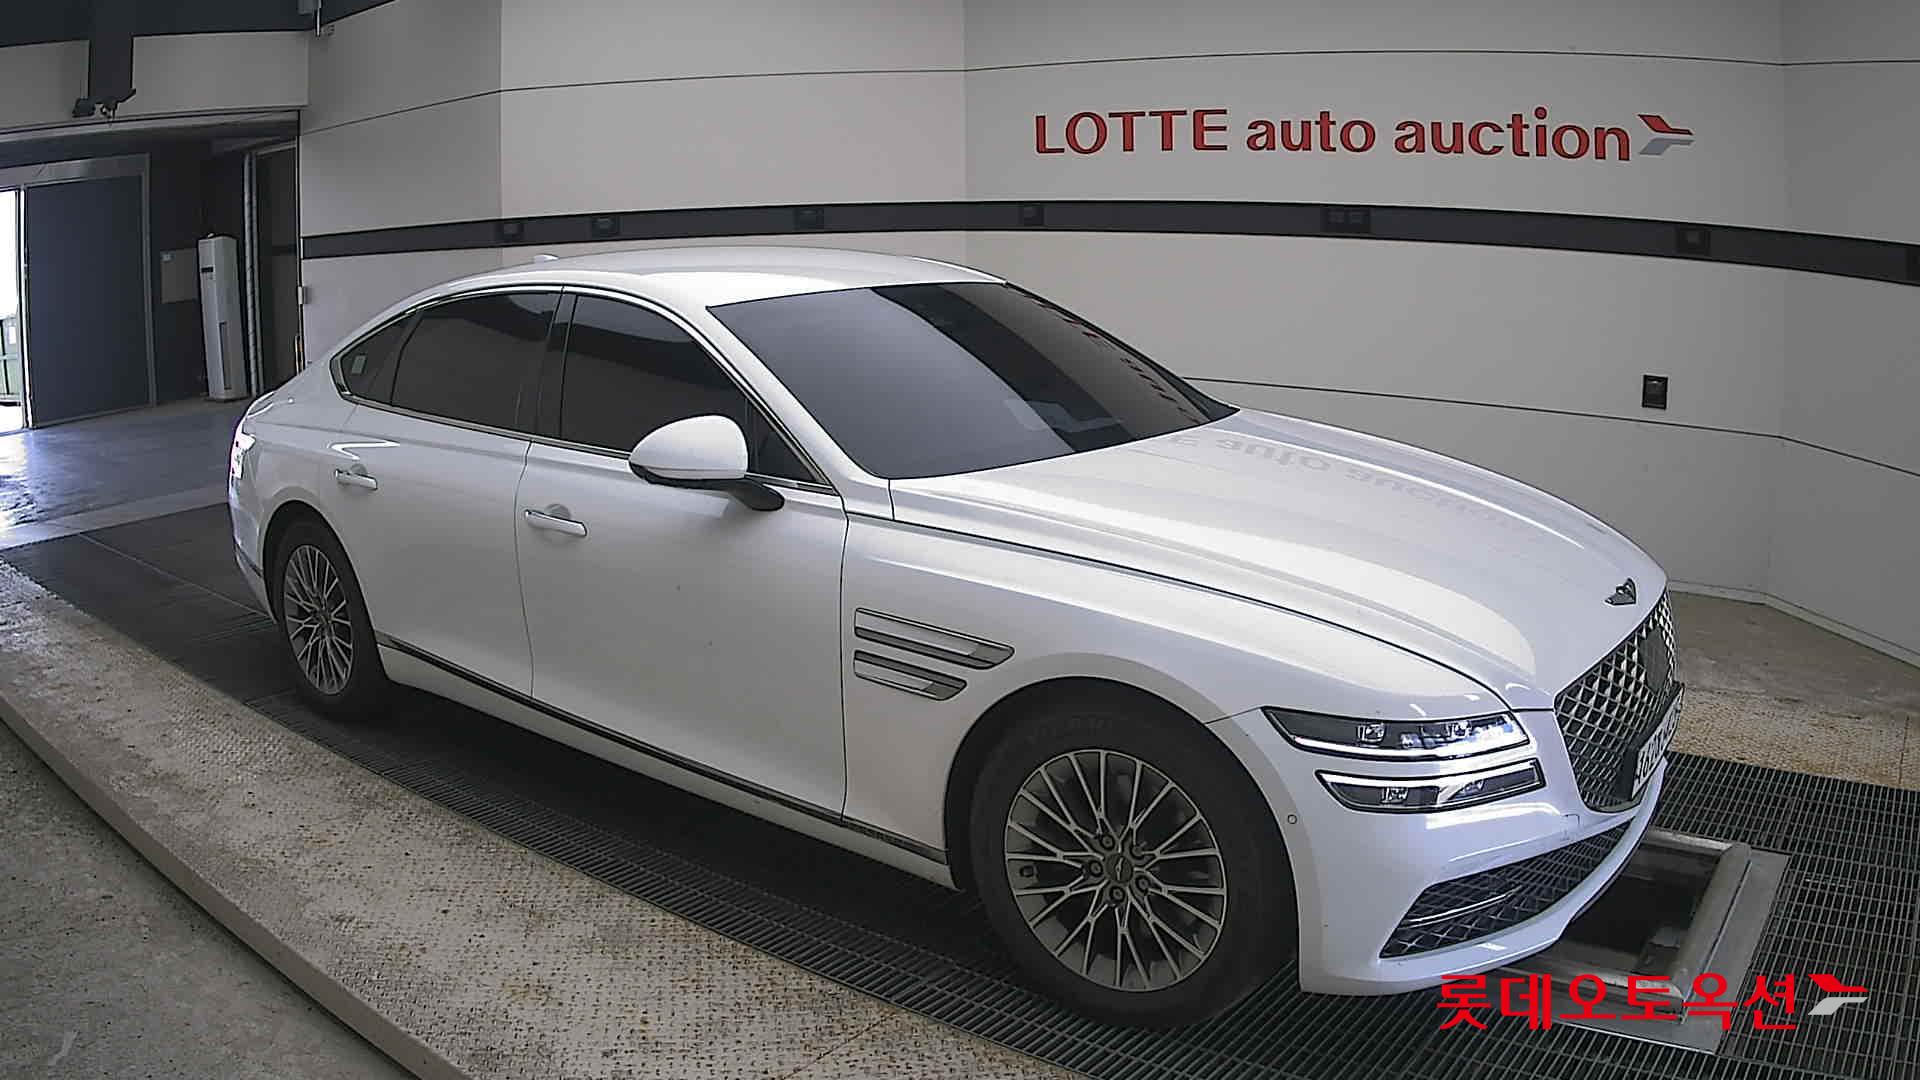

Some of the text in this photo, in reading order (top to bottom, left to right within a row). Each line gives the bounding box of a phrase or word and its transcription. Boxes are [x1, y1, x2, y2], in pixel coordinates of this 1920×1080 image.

[1035, 106, 1631, 161] LOTTE auto auction
